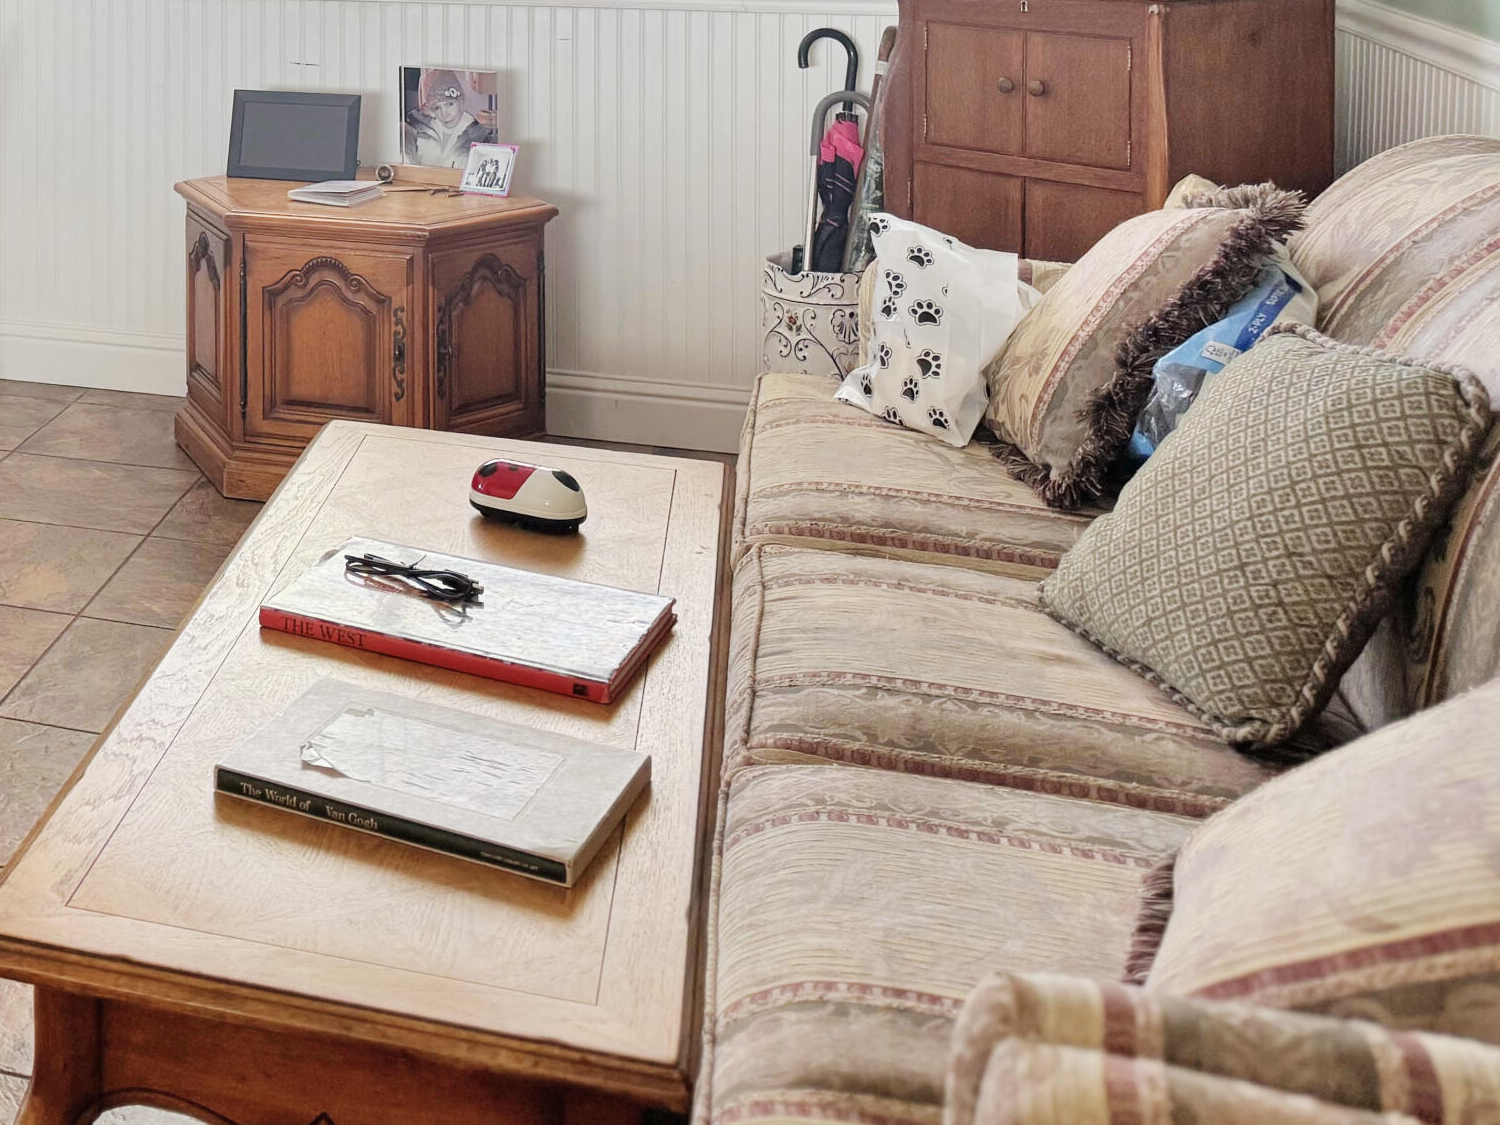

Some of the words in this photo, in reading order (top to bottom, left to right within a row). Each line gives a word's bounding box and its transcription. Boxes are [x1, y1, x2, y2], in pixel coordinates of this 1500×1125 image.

[281, 616, 314, 636] THE
[319, 624, 367, 649] WEST
[240, 782, 261, 796] The
[265, 788, 297, 808] World
[299, 800, 311, 811] of
[326, 805, 346, 821] Van
[348, 812, 378, 830] Gogh
